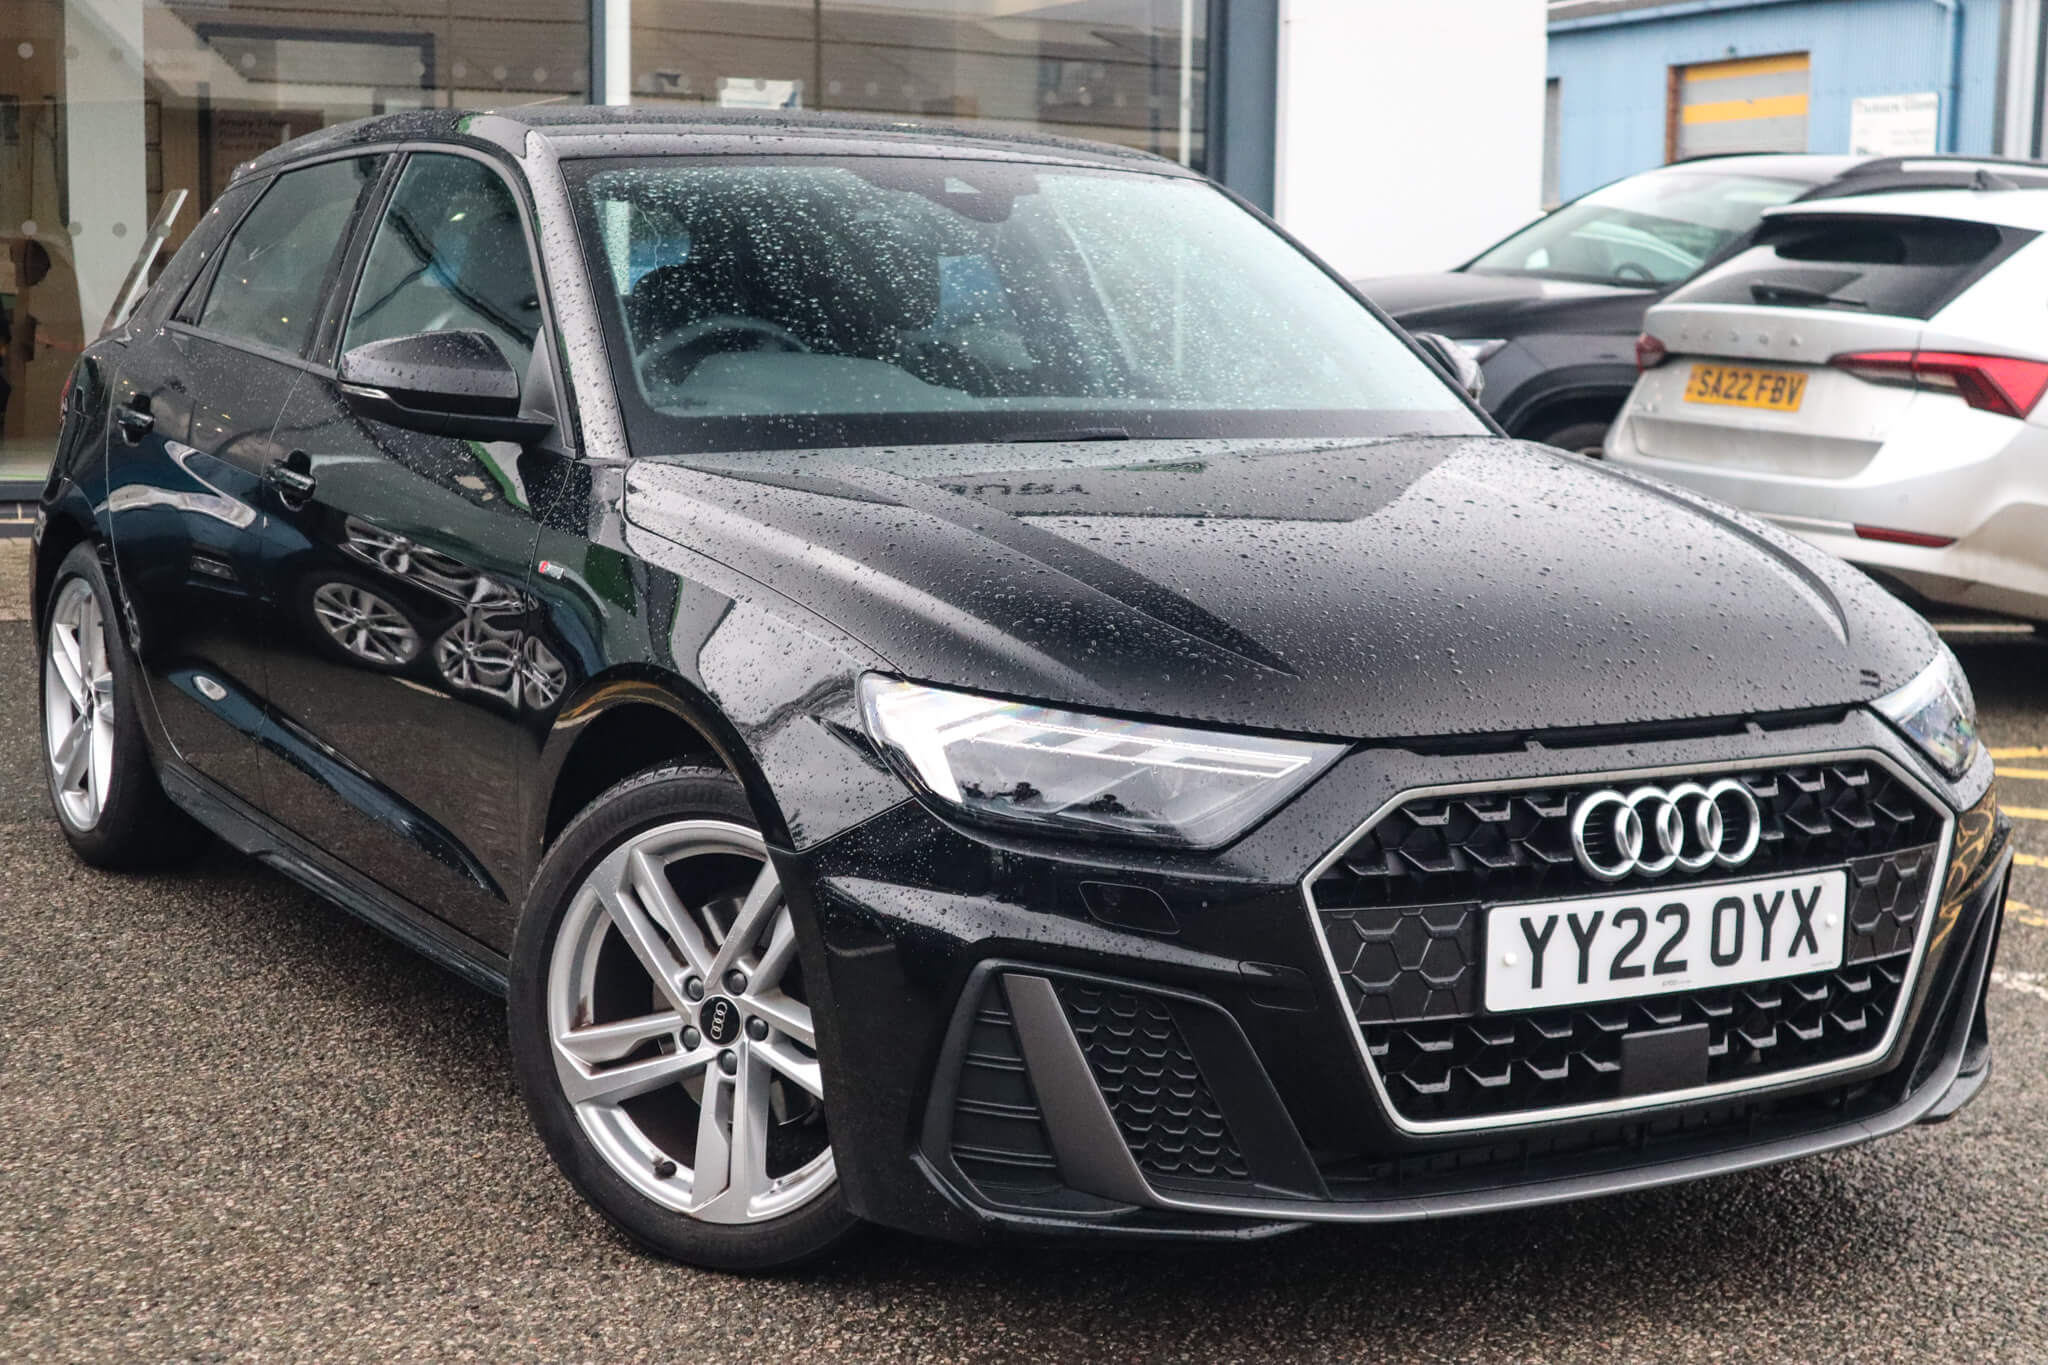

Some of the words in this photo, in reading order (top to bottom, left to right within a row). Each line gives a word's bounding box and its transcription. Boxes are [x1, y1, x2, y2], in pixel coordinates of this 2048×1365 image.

[1697, 368, 1753, 401] SA22
[1755, 374, 1802, 405] FBV
[1520, 902, 1690, 989] YY22
[1710, 885, 1822, 967] OYX
